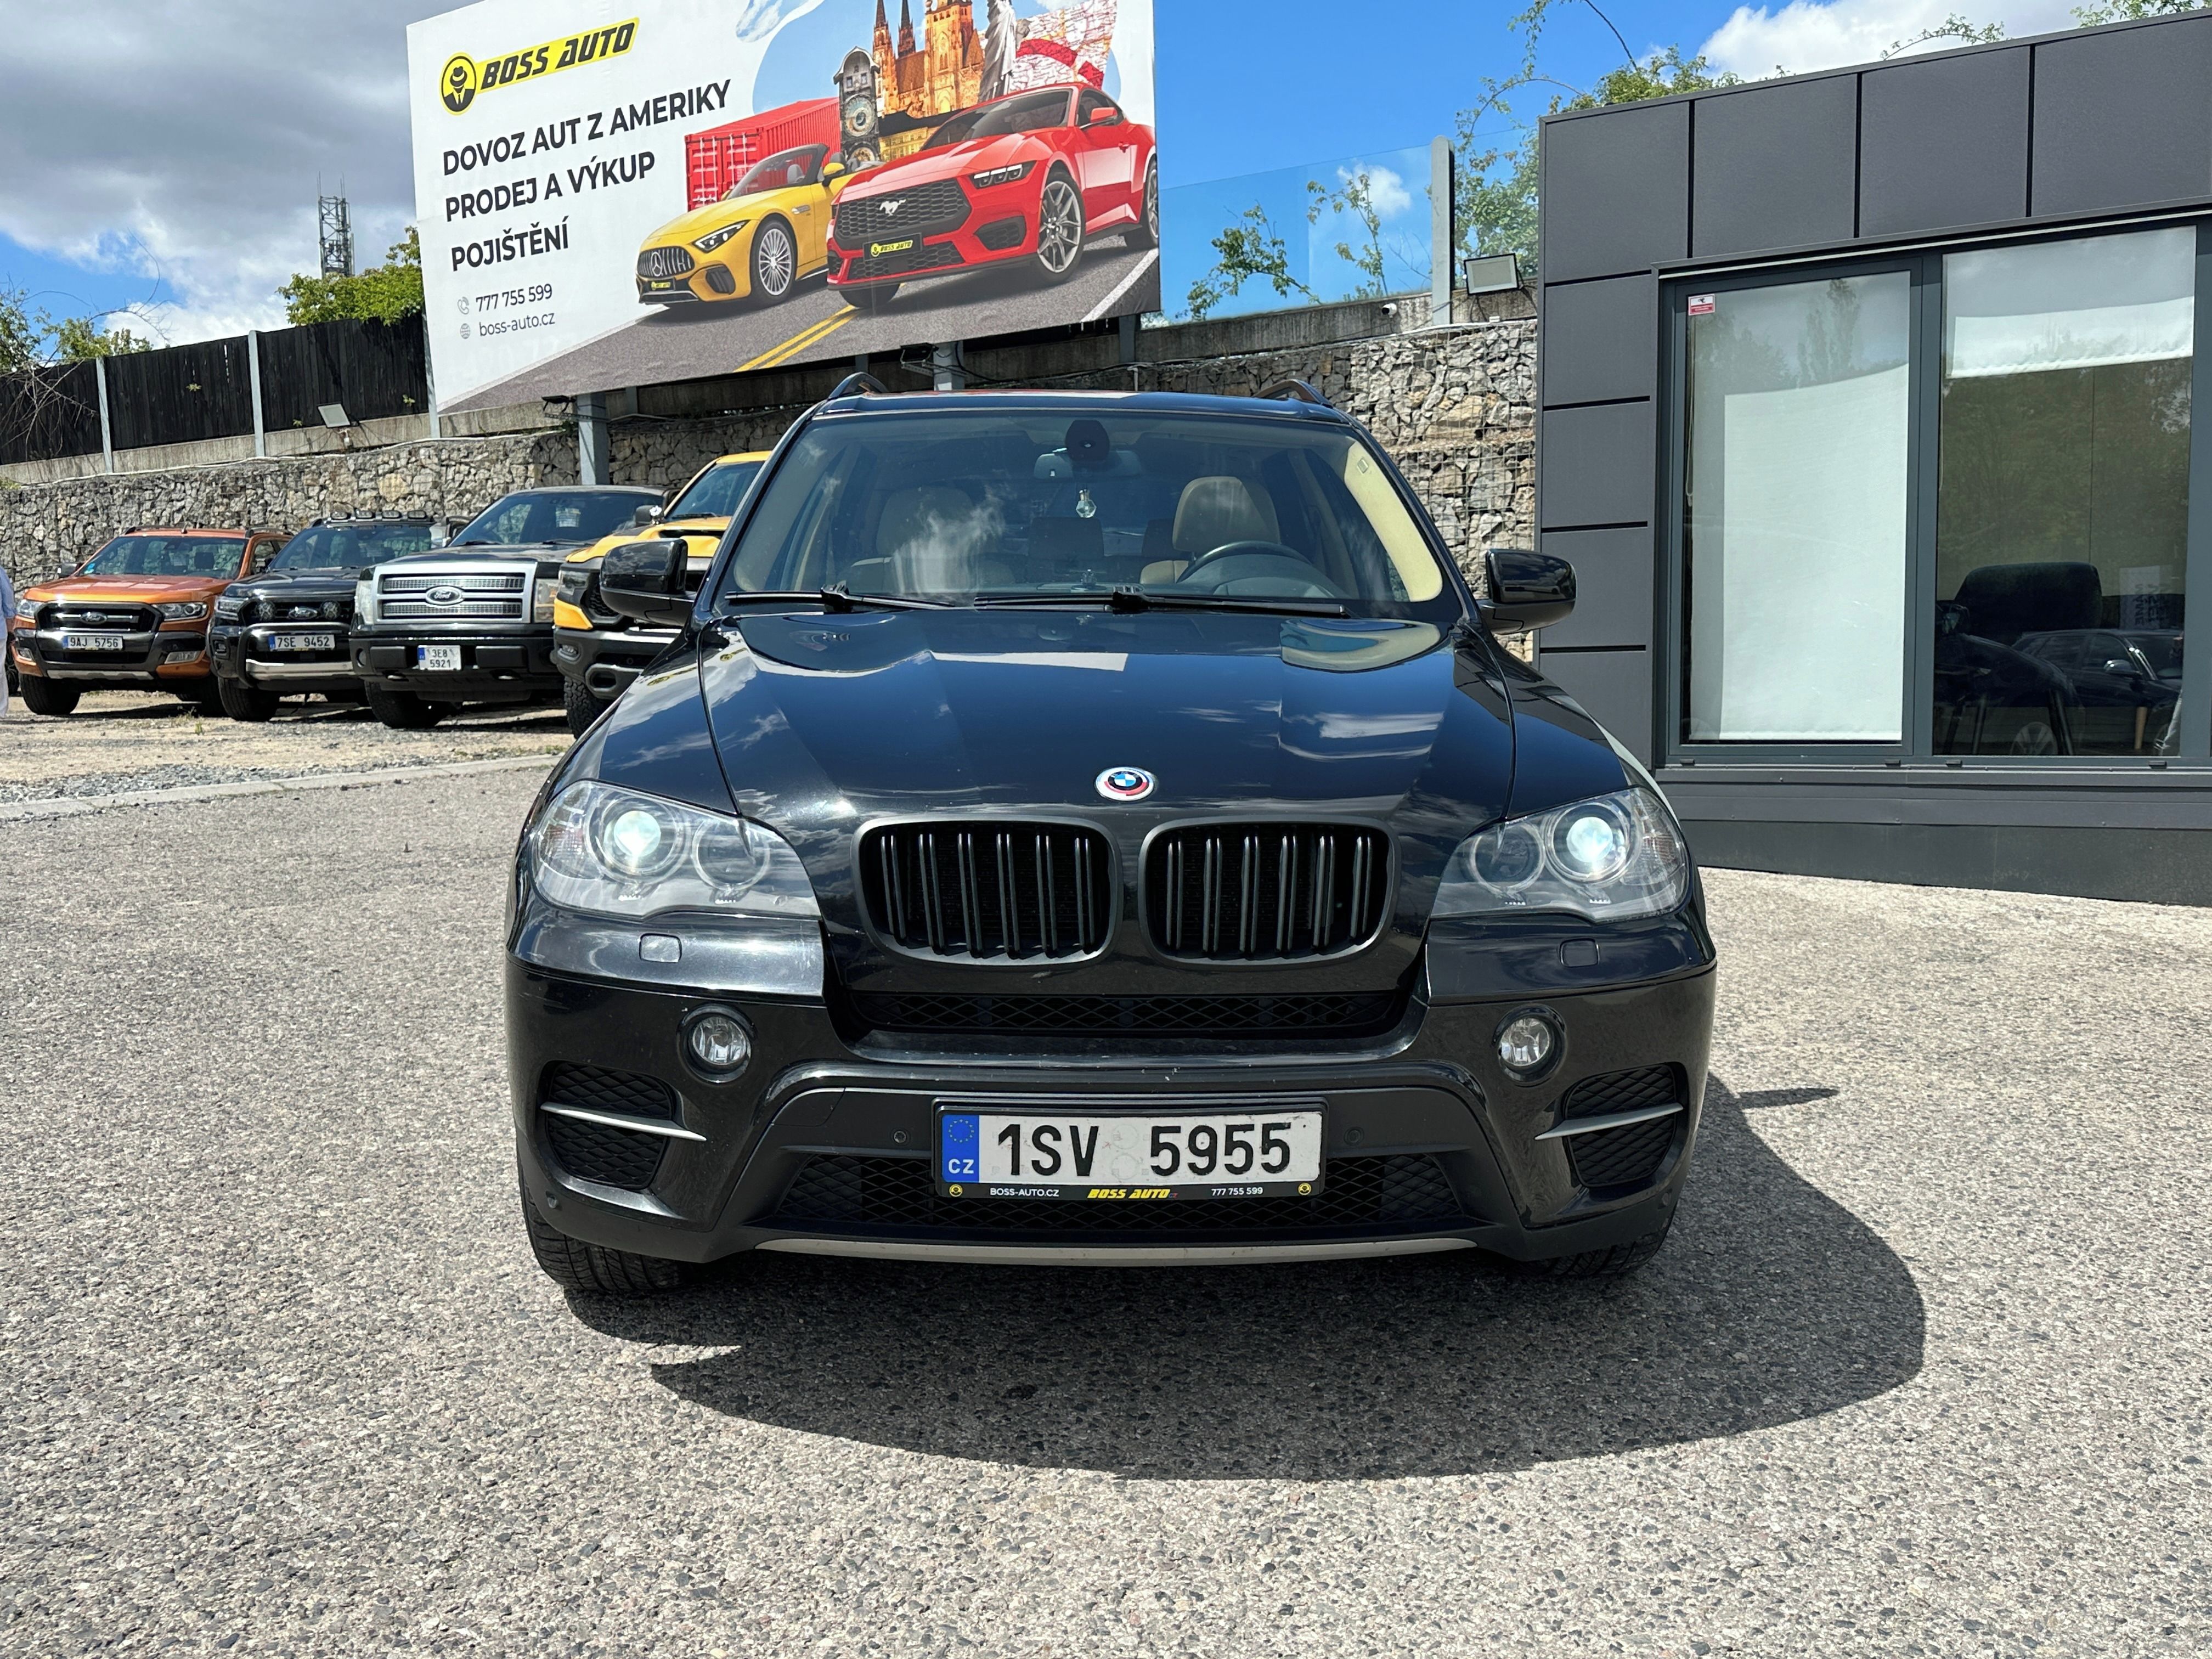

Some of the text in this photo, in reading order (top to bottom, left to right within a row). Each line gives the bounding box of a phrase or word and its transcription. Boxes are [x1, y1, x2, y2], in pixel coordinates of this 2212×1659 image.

[481, 22, 635, 90] BOSS AUTO
[443, 79, 731, 176] DOVOZ AUT Z AMERIKY
[445, 151, 654, 222] PRODEJ A VÝKUP
[452, 216, 569, 272] POJIŠTĚNÍ
[476, 283, 552, 312] 777 755 599
[479, 313, 555, 336] boss-auto.cz
[70, 637, 119, 647] 9AJ 5756
[277, 636, 330, 647] 7SE 9452
[432, 649, 448, 657] 3E8
[430, 659, 451, 668] 5921
[998, 1122, 1291, 1177] 1SV 5955
[948, 1159, 974, 1174] CZ
[990, 1188, 1059, 1197] BOSS-AUTO.CZ
[1087, 1189, 1127, 1198] BOSS
[1128, 1189, 1170, 1199] AUTO
[1246, 1187, 1263, 1195] 599
